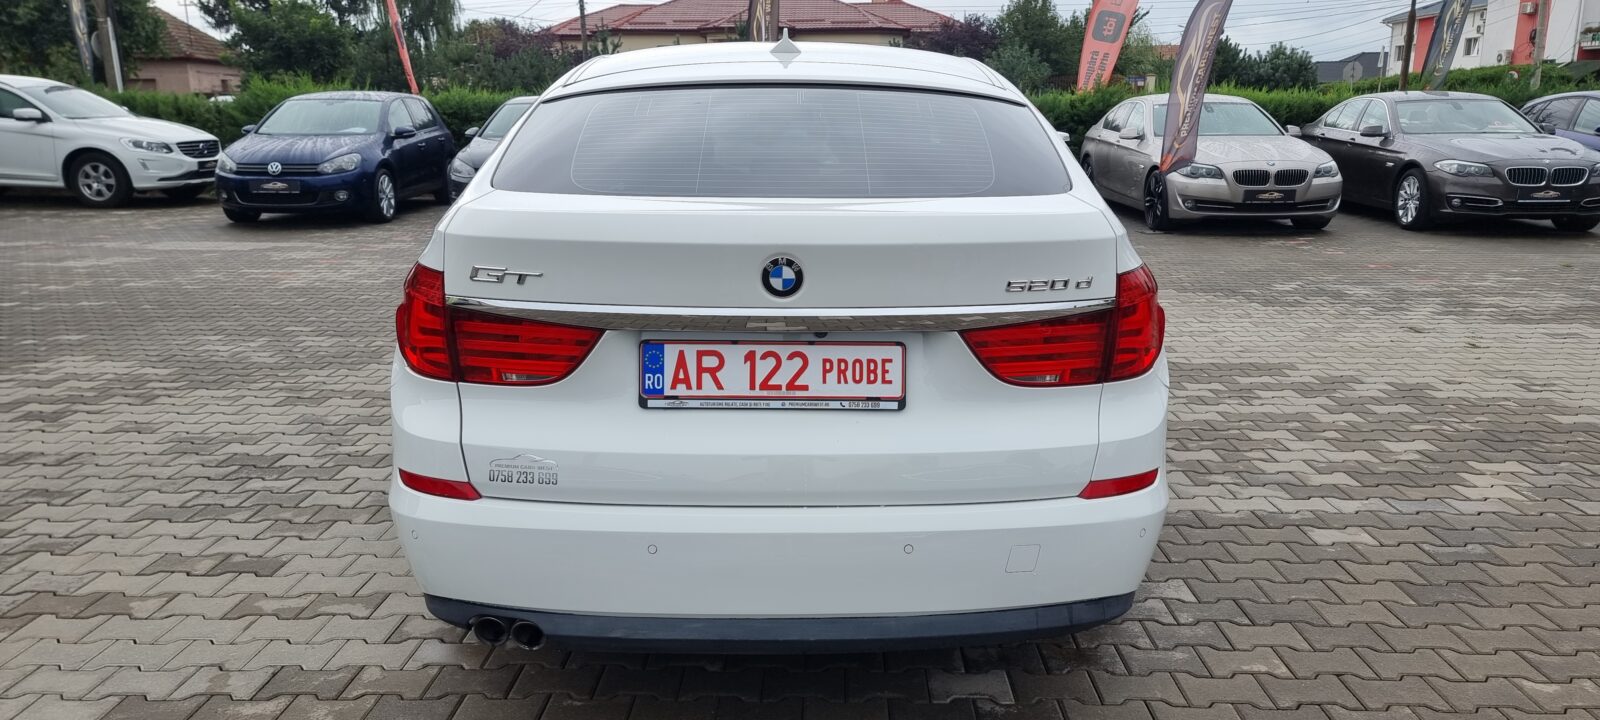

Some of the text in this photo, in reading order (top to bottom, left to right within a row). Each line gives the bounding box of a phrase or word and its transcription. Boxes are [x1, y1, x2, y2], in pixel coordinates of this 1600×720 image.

[1103, 17, 1118, 36] tbi
[1206, 13, 1221, 48] WEST
[469, 265, 544, 285] GT
[1005, 278, 1070, 293] 520
[669, 349, 894, 392] AR 122 PROBE
[644, 372, 664, 389] RO
[489, 469, 558, 485] 0758 233 699
